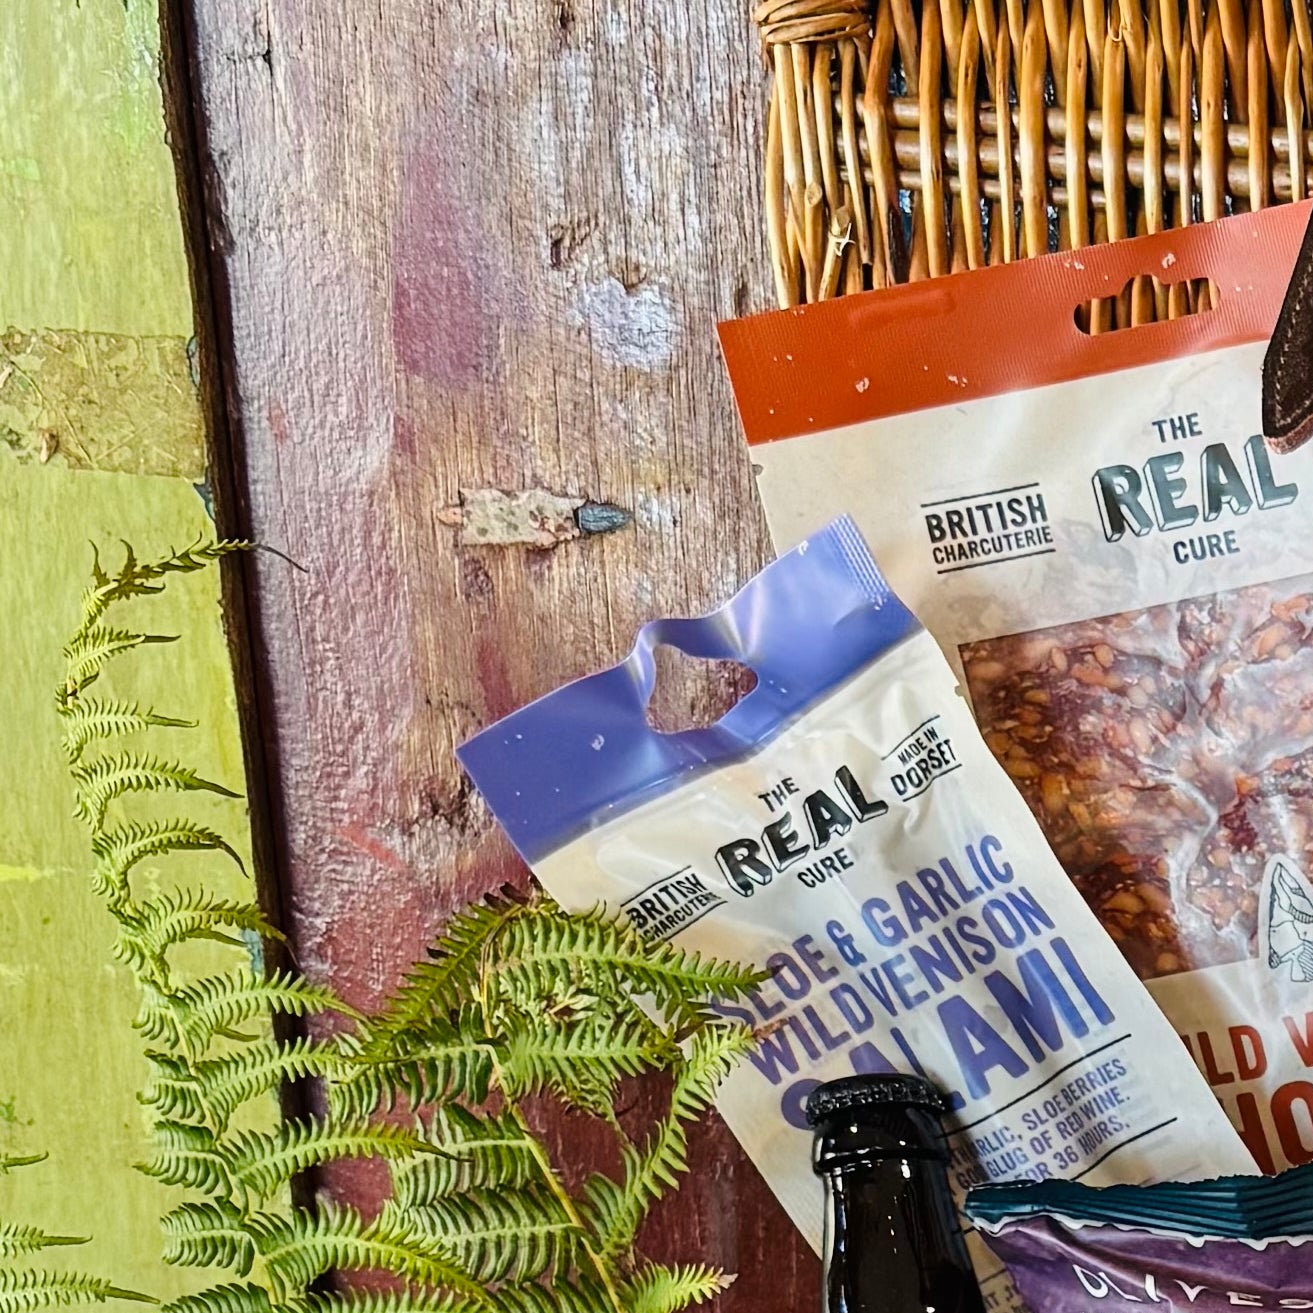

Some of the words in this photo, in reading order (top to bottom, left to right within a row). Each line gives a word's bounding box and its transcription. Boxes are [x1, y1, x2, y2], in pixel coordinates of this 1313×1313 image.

[1151, 413, 1203, 443] THE
[1092, 434, 1298, 543] REAL
[924, 493, 1049, 544] BRITISH
[932, 525, 1053, 565] CHARCUTERIE
[1172, 530, 1240, 564] CURE
[716, 764, 889, 898] REAL
[797, 847, 854, 890] CURE
[861, 835, 1016, 949] GARLIC
